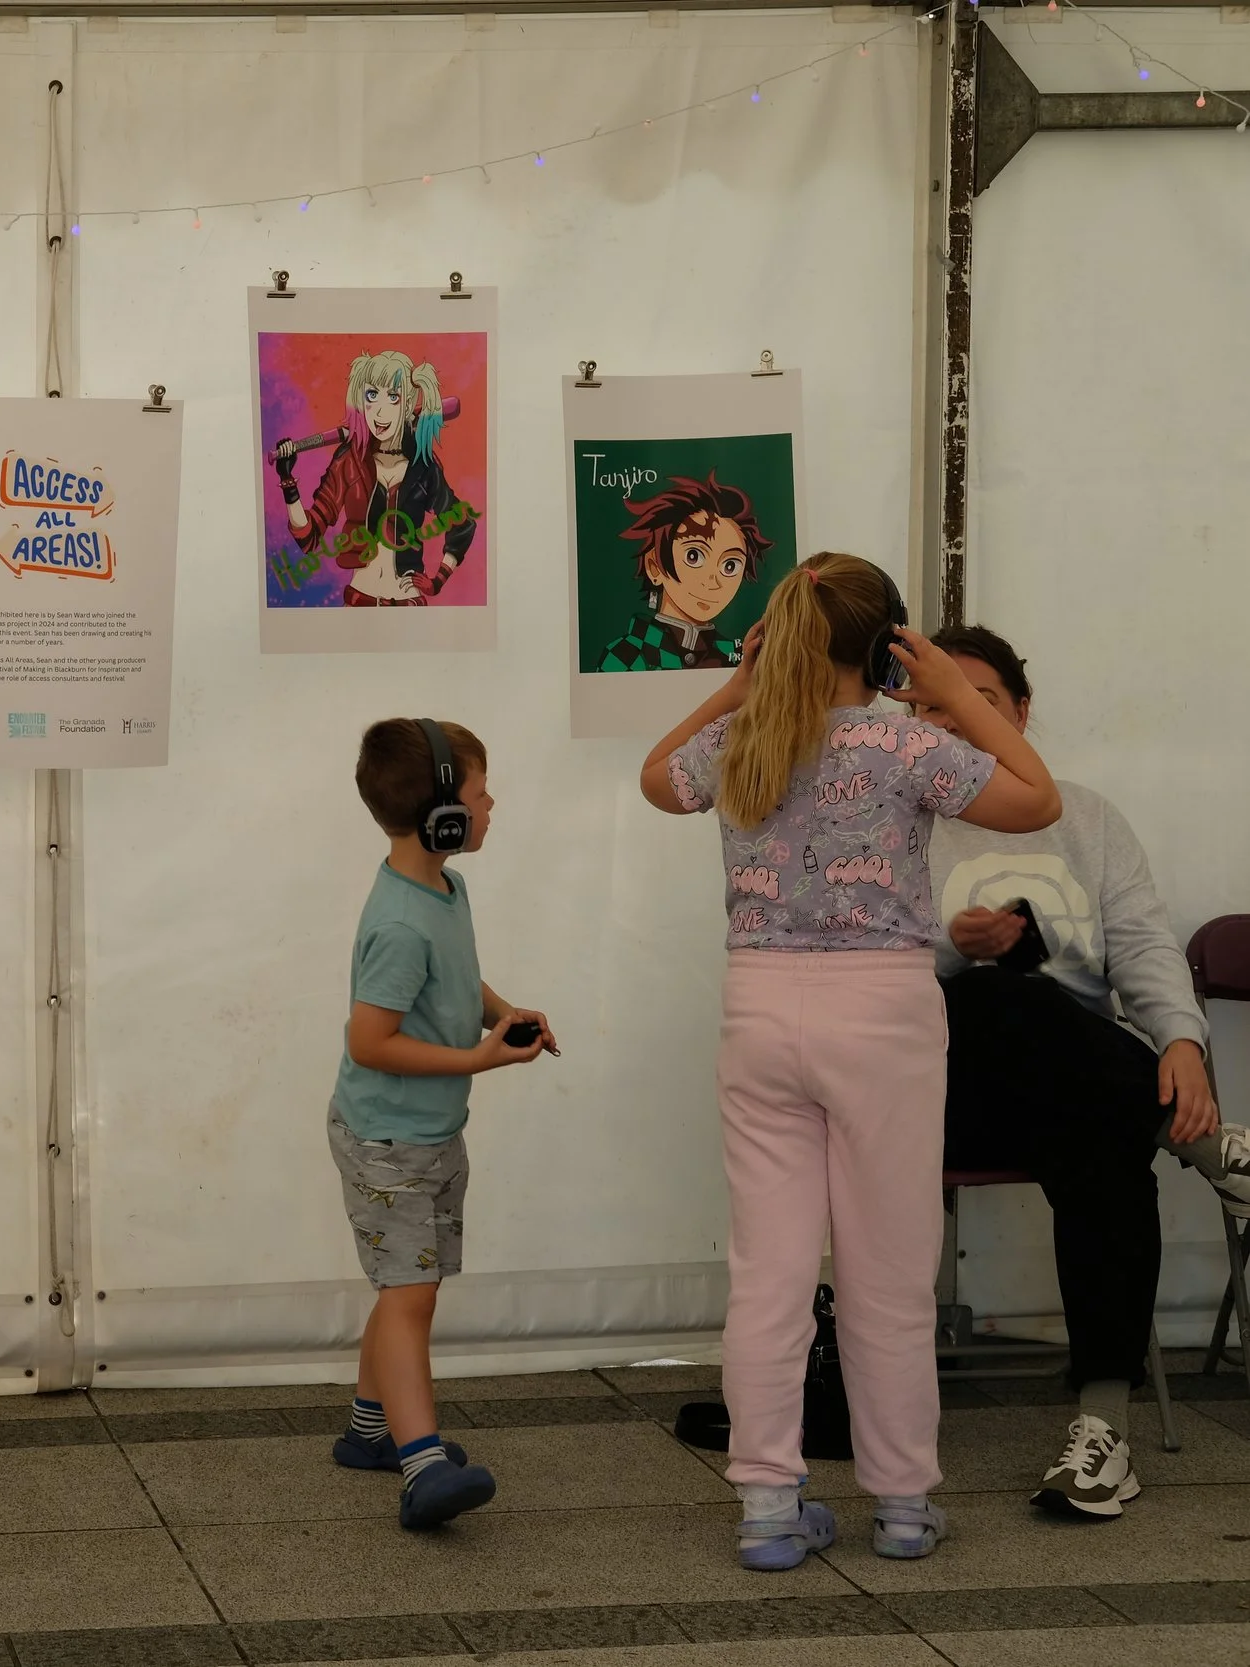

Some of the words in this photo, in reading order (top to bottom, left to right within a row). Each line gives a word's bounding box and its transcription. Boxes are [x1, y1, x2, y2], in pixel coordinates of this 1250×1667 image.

[13, 457, 104, 504] ACCESS
[582, 453, 658, 500] Tanjiro
[35, 511, 76, 529] ALL
[12, 531, 102, 569] AREAS!
[271, 525, 379, 592] Harley
[378, 500, 483, 552] Quinn
[7, 620, 30, 628] project
[81, 630, 106, 638] drawing
[119, 630, 143, 638] creating
[22, 666, 46, 674] Making
[98, 666, 130, 674] inspiration
[117, 657, 146, 665] producers
[59, 725, 106, 733] Foundation
[829, 722, 899, 753] COOL
[813, 770, 878, 809] LOVE
[730, 864, 780, 900] COOL
[824, 854, 894, 888] COOL
